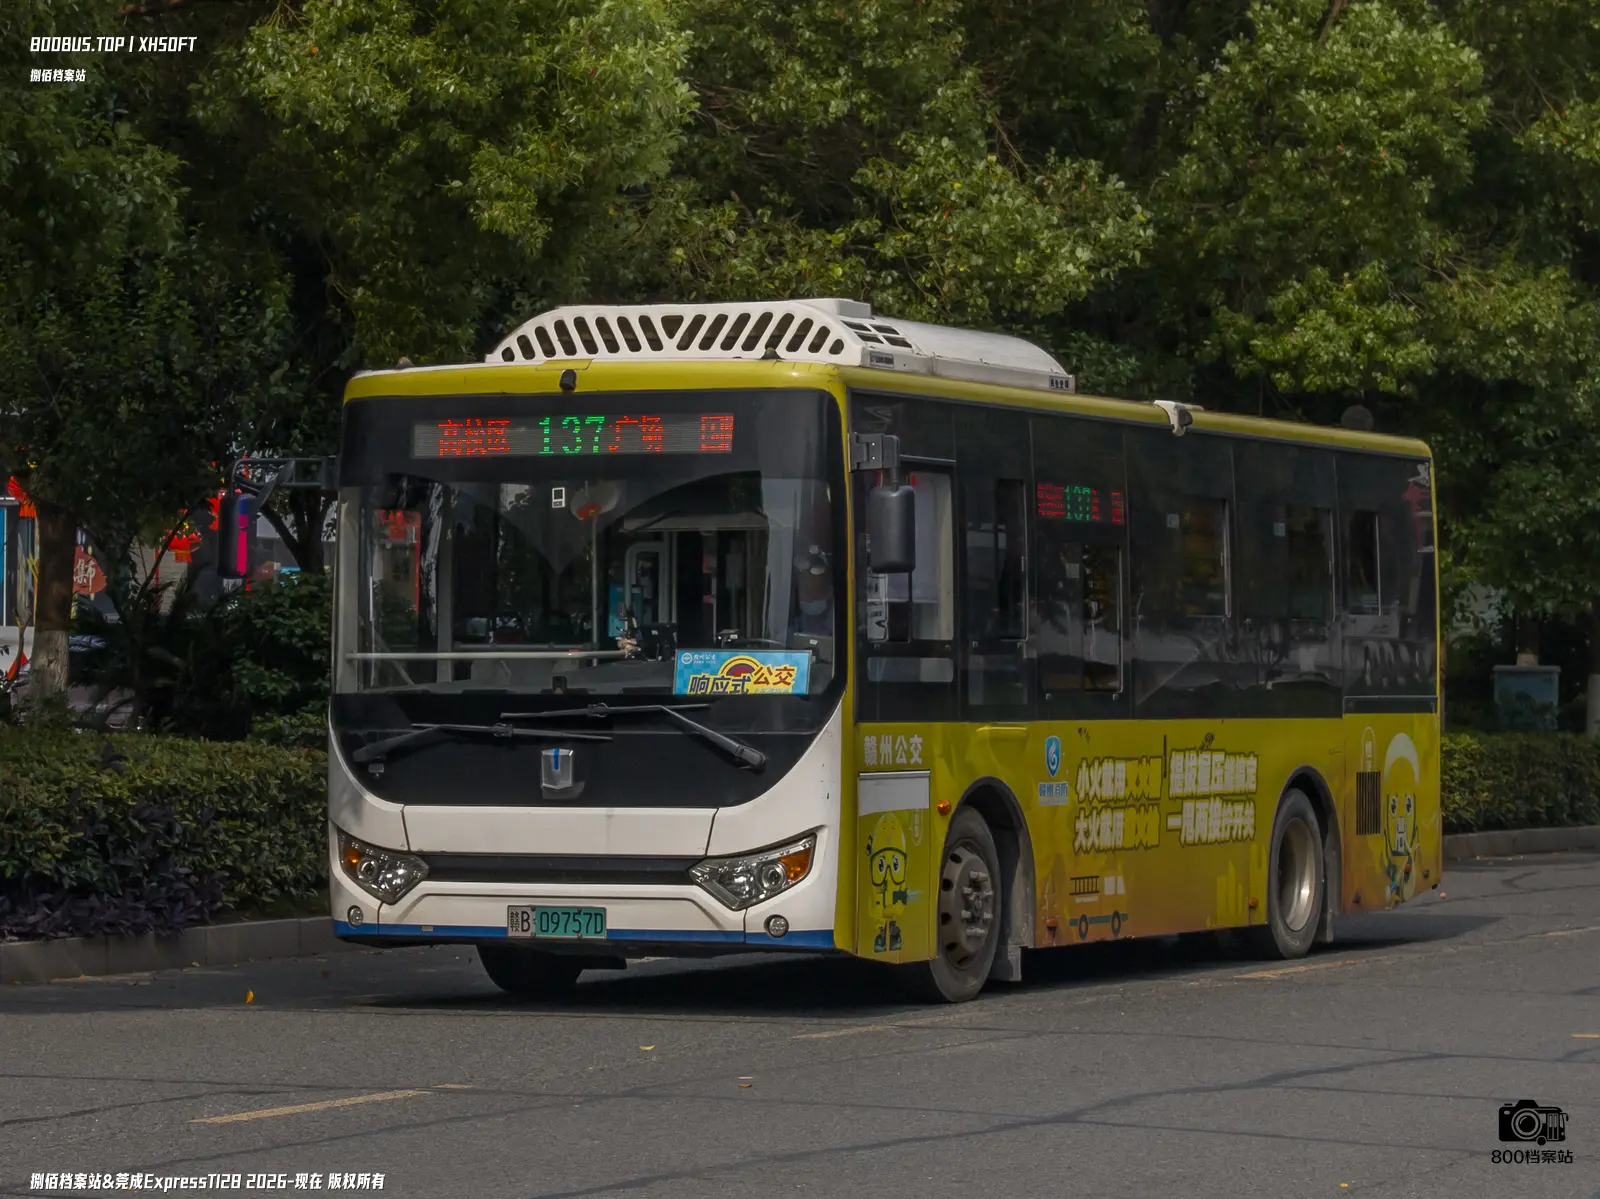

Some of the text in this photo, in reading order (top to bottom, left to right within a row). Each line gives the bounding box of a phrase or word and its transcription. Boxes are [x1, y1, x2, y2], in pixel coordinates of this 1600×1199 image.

[538, 415, 605, 454] 137
[689, 664, 796, 694] 响应式 公交
[863, 734, 924, 766] 赣州公交
[539, 911, 604, 934] 09757D
